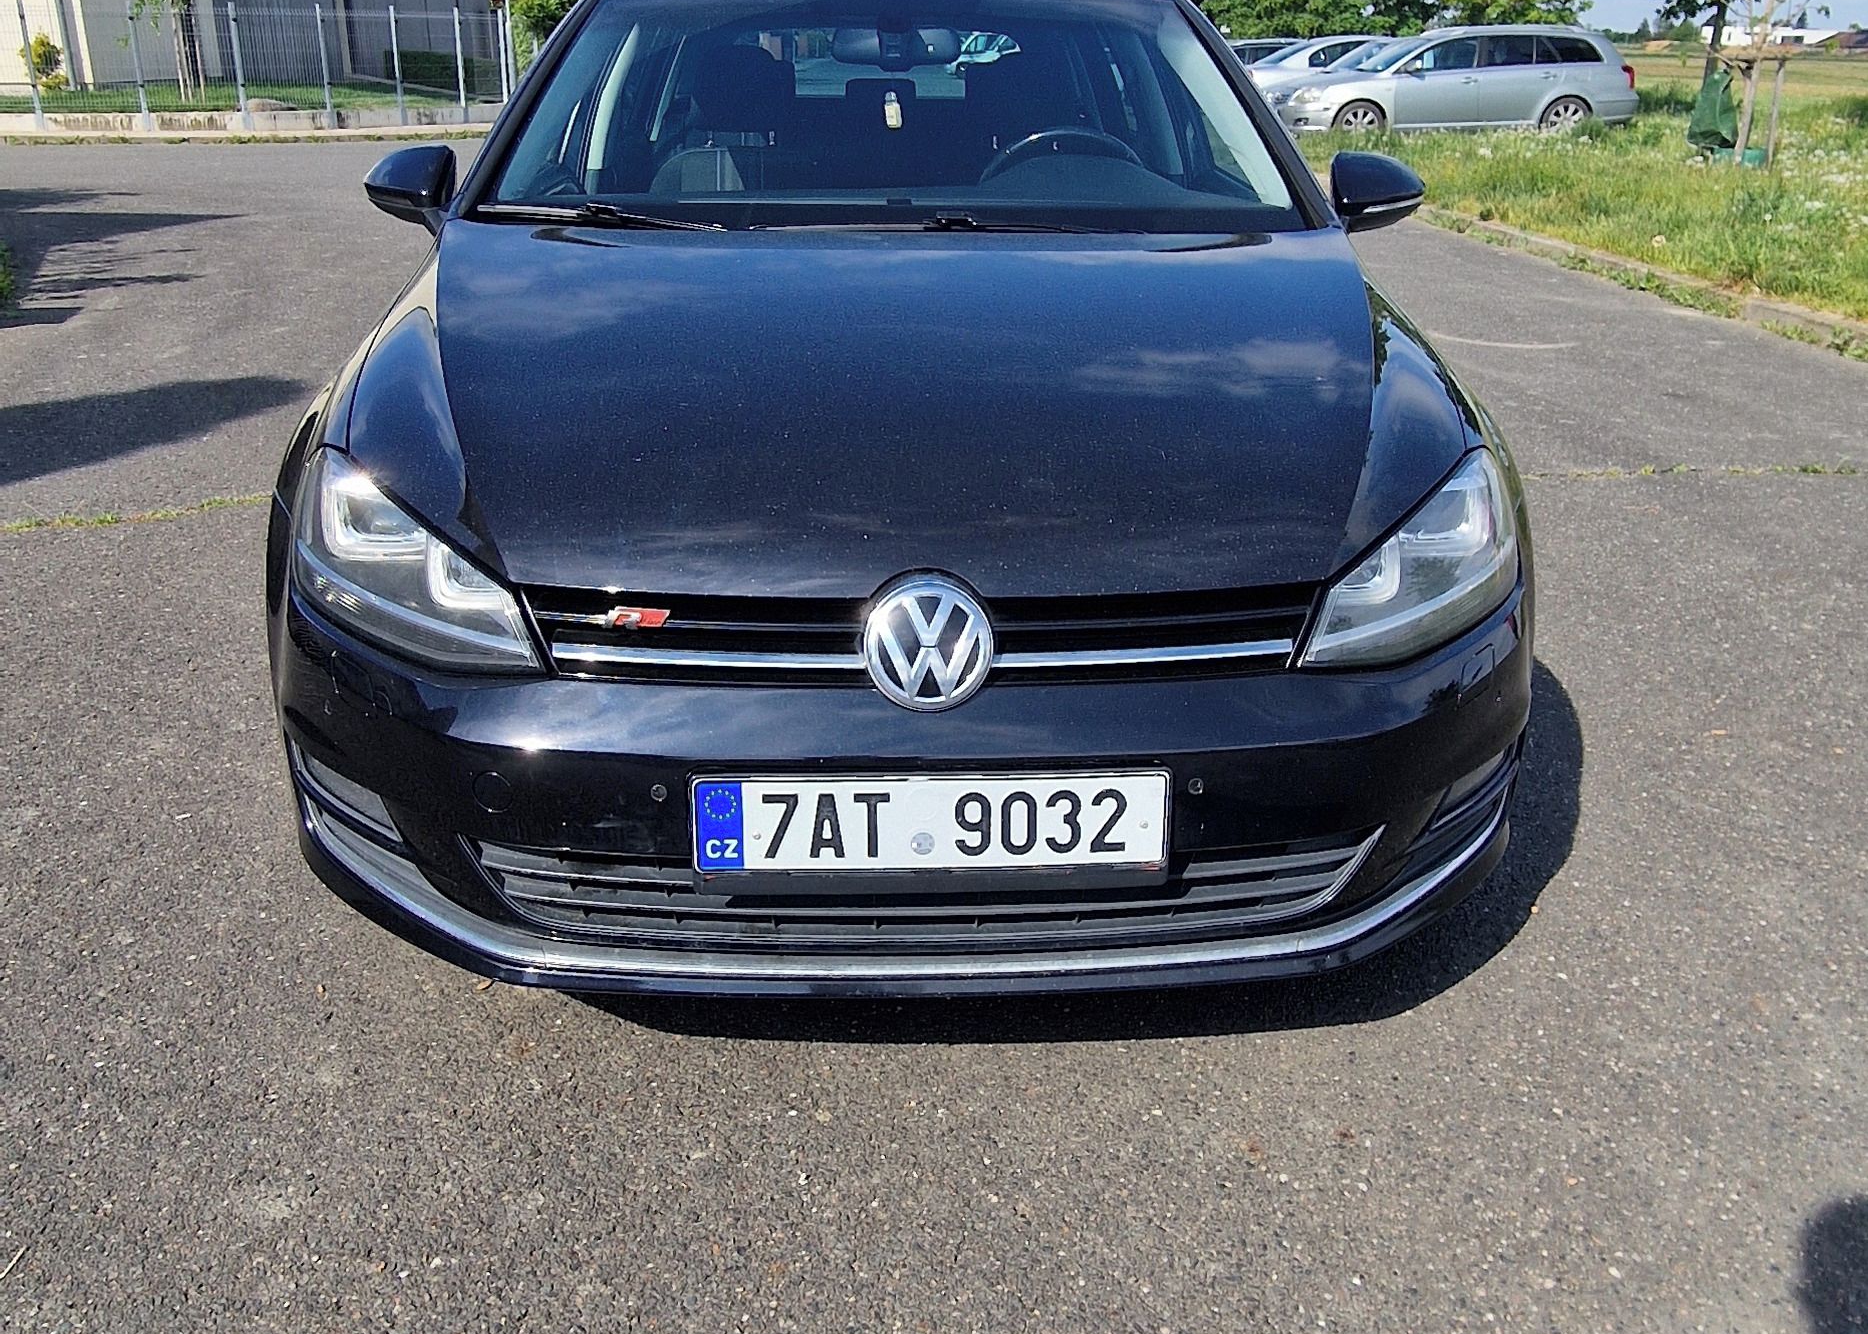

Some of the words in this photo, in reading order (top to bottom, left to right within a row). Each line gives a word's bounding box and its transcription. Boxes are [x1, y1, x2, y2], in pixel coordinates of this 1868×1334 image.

[873, 590, 985, 702] VW
[705, 838, 739, 859] CZ
[761, 792, 890, 859] 7AT
[954, 788, 1128, 856] 9032
